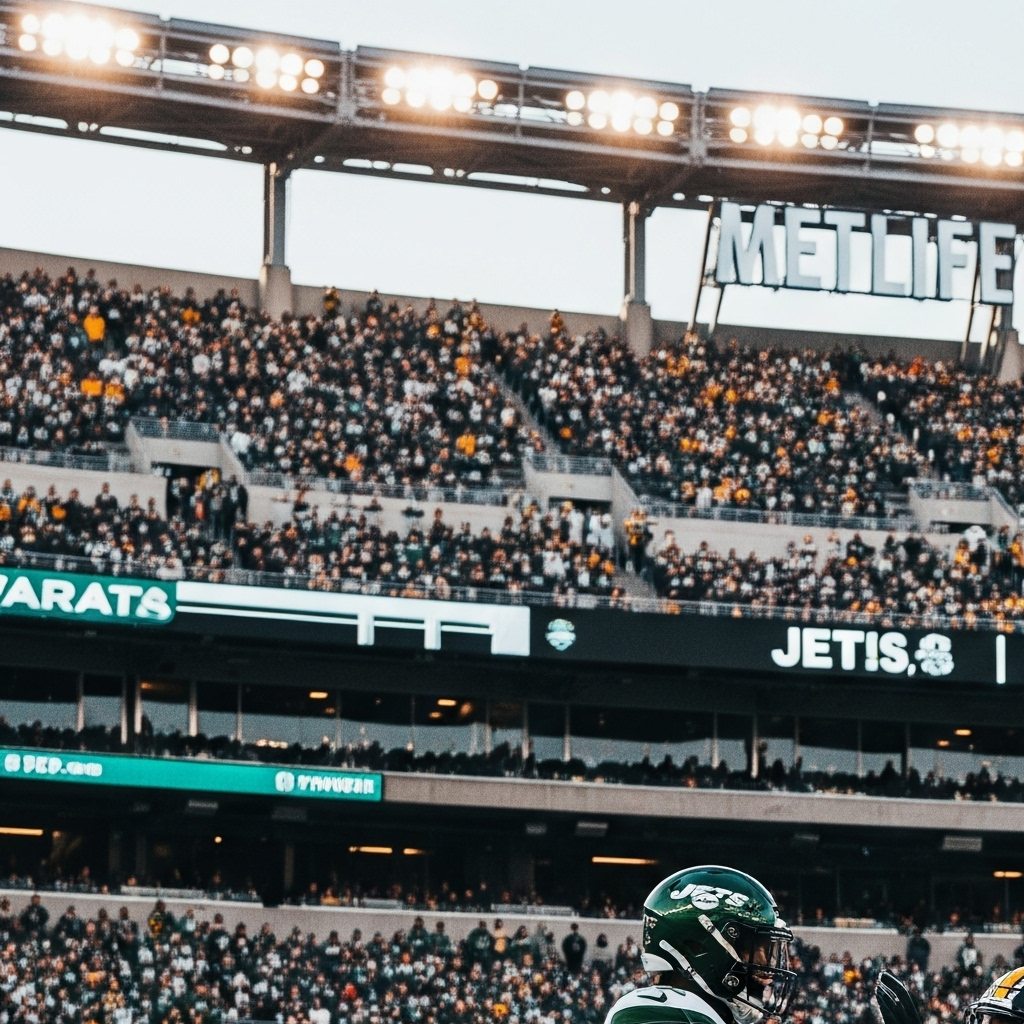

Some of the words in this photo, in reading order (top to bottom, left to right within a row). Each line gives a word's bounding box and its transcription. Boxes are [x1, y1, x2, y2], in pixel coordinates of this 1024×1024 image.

[716, 201, 1017, 305] METLIFE
[0, 574, 172, 621] ARATS
[670, 883, 749, 907] JETS
